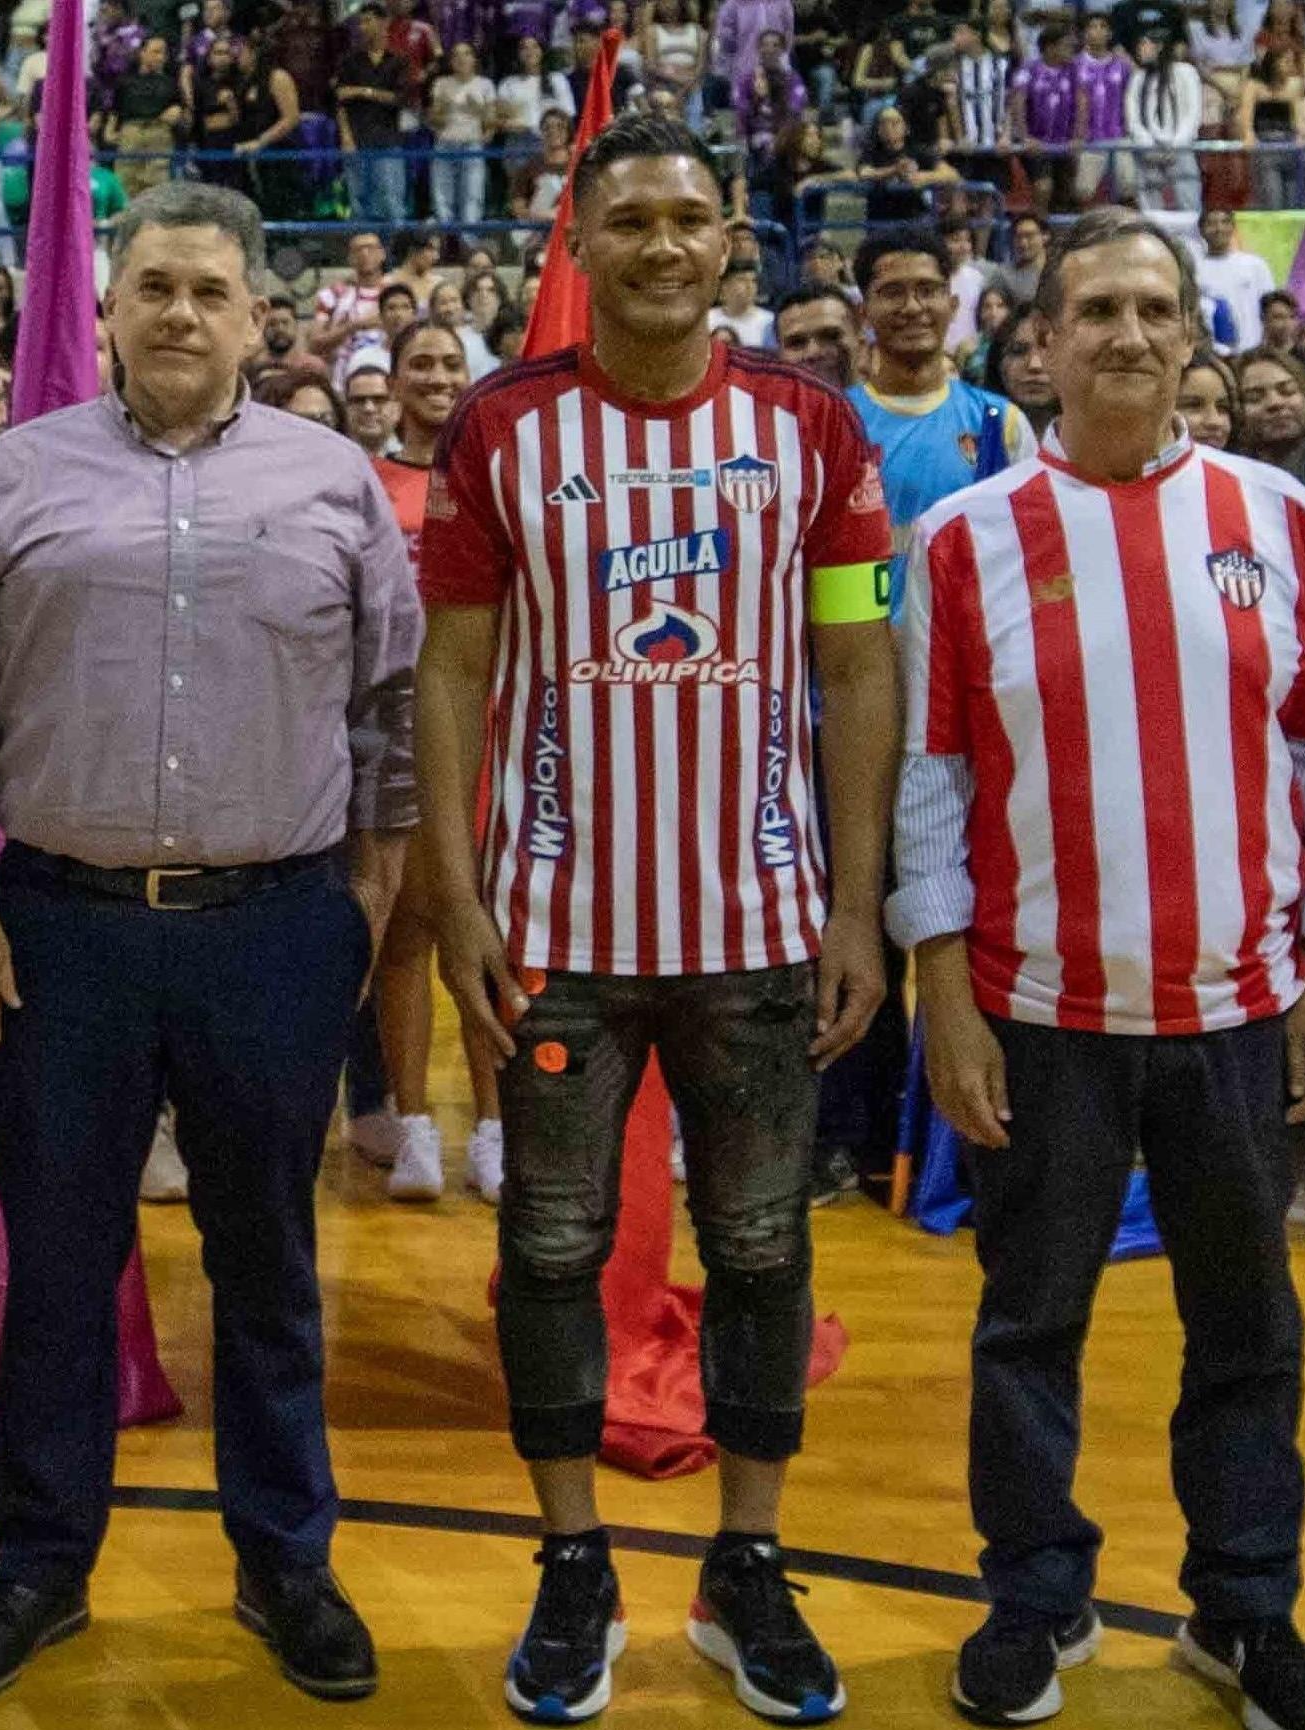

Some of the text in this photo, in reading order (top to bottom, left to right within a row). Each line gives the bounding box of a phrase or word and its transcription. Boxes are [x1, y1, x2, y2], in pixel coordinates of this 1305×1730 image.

[606, 532, 721, 590] AGUILA
[569, 660, 761, 684] OLIMPICA
[529, 682, 569, 859] Wplay.co
[757, 689, 795, 867] Wplay.co
